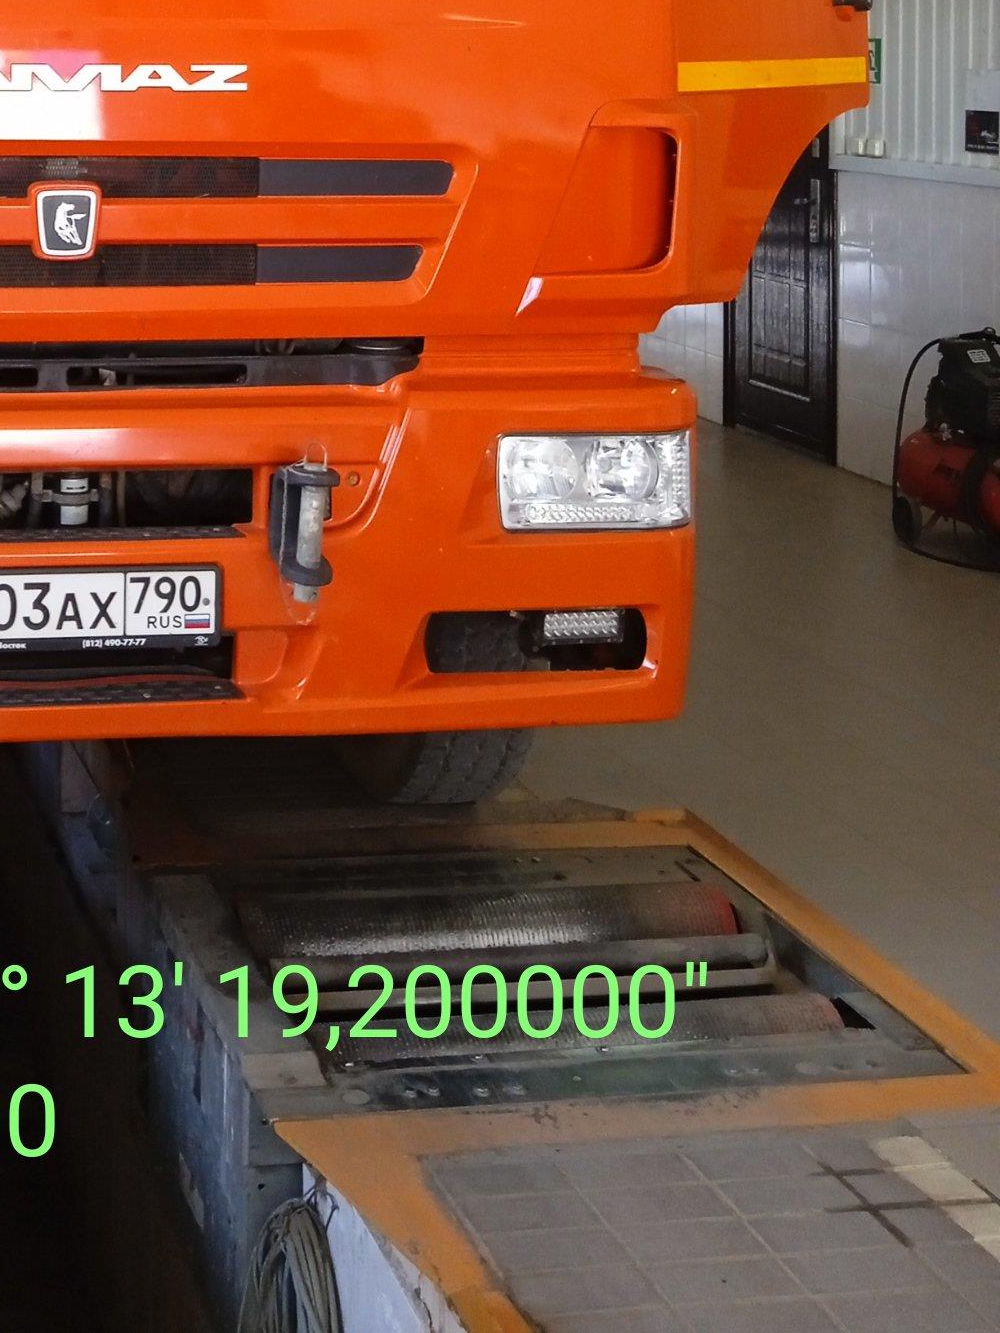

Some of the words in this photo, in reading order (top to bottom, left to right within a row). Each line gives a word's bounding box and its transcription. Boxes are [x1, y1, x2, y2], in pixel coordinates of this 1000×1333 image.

[129, 575, 201, 614] 790
[147, 615, 182, 629] RUS
[82, 639, 103, 649] (812)
[104, 638, 147, 647] 490-77-77
